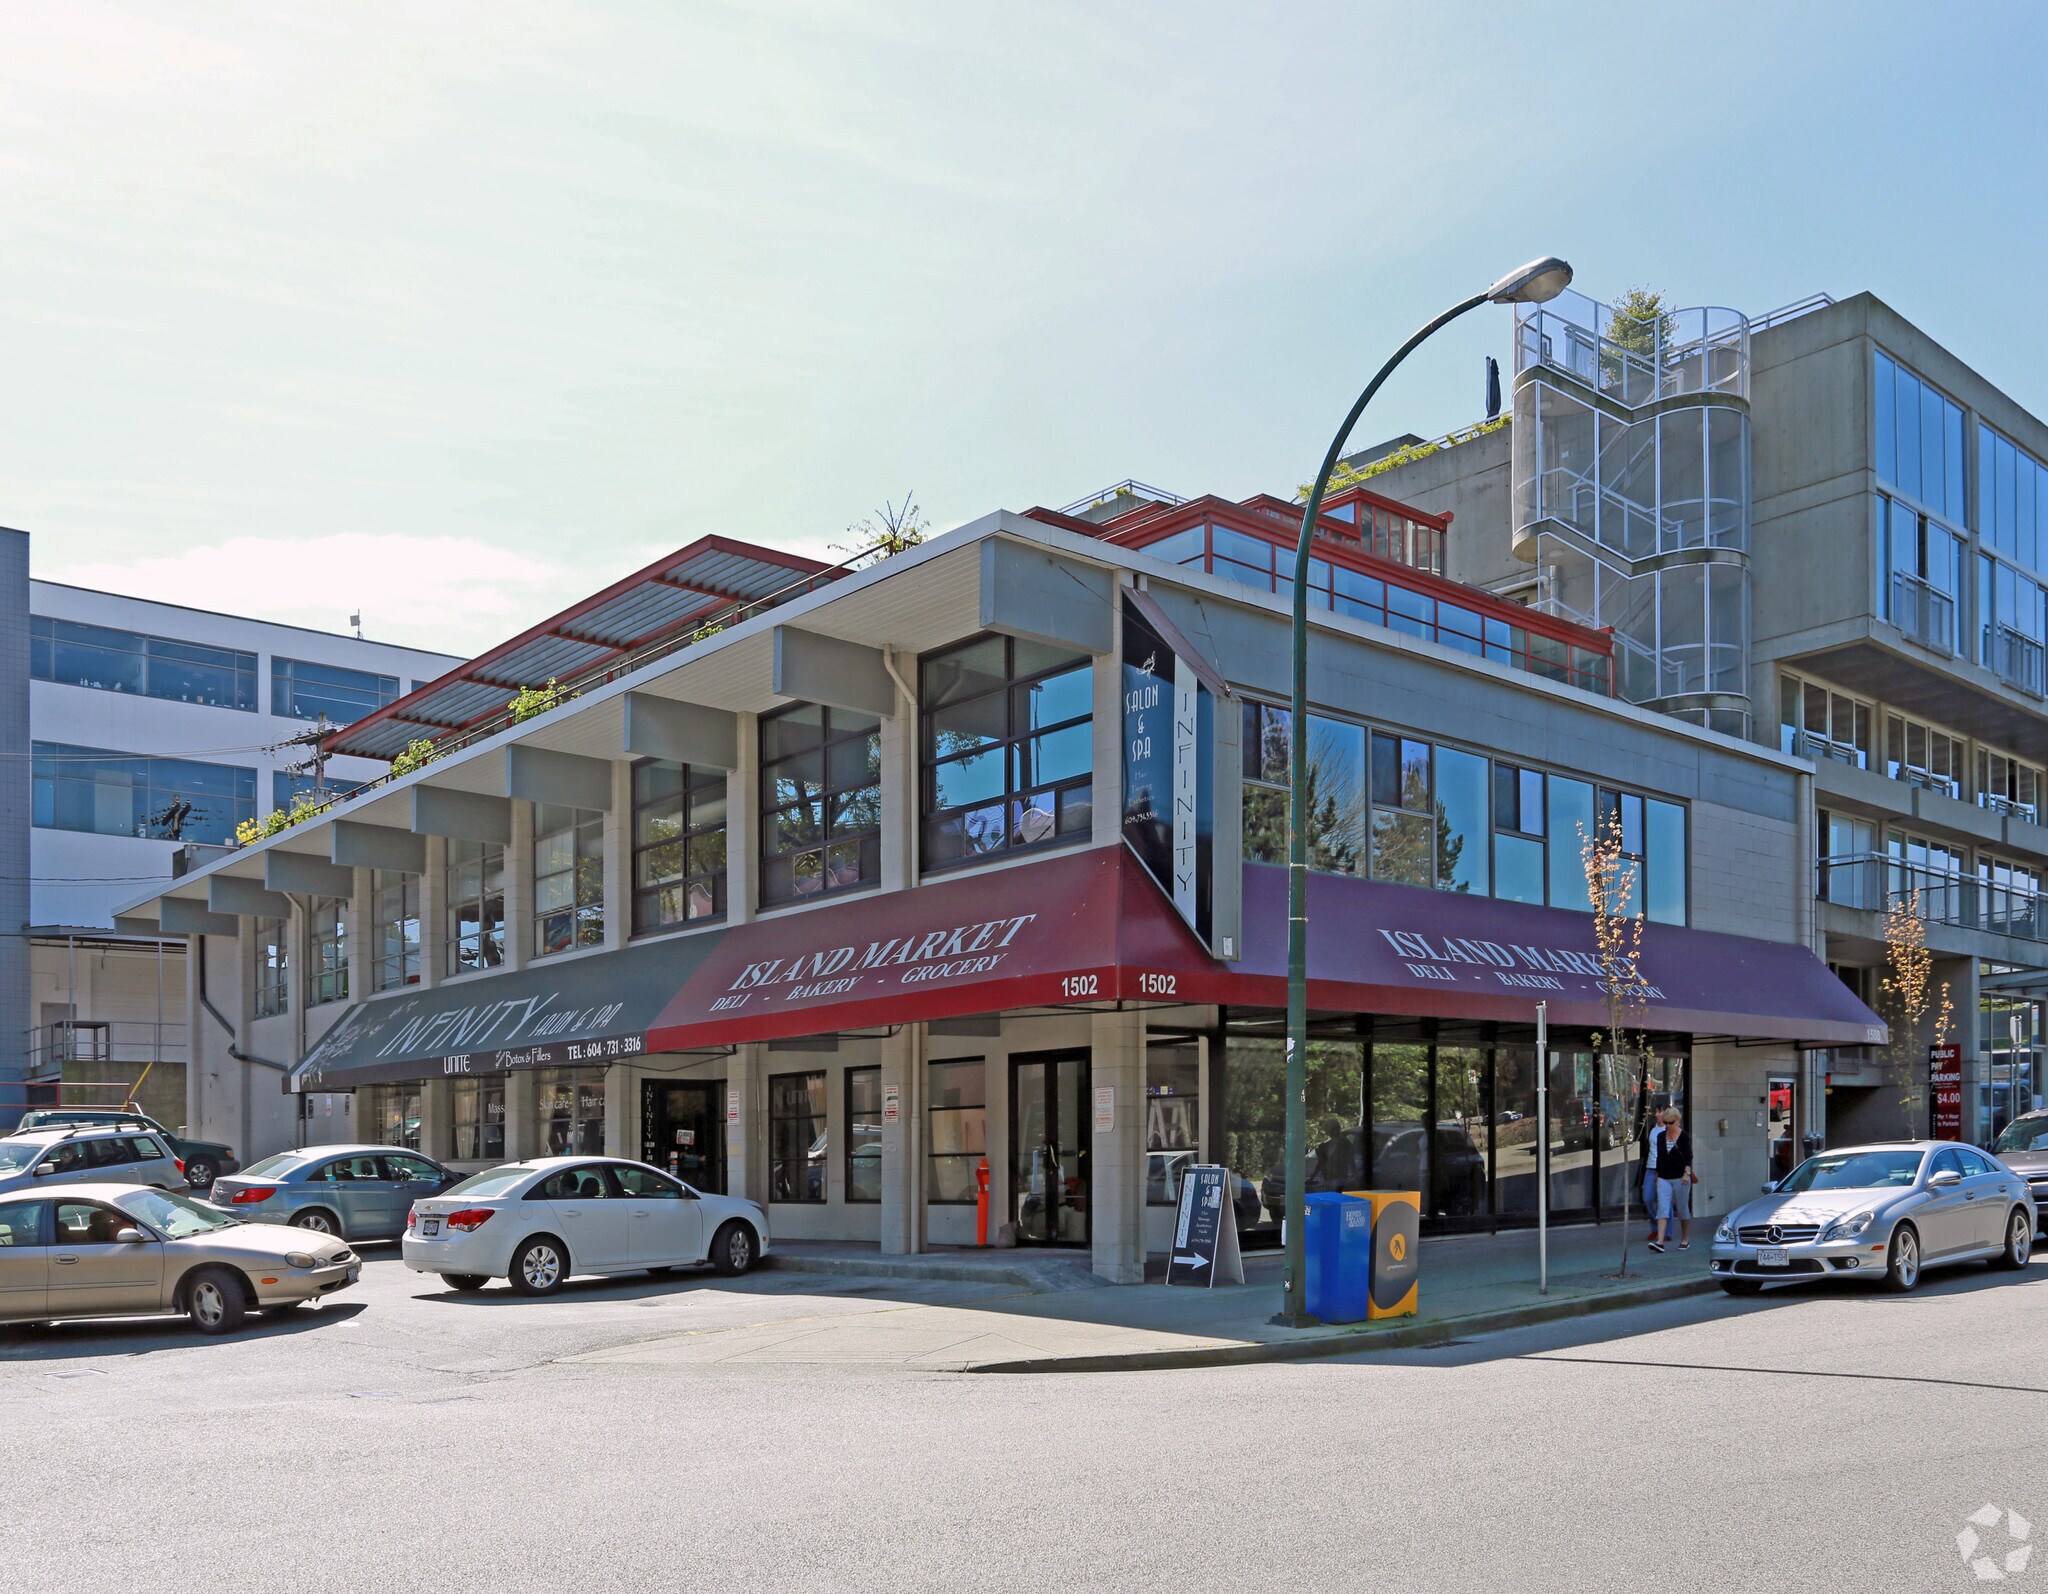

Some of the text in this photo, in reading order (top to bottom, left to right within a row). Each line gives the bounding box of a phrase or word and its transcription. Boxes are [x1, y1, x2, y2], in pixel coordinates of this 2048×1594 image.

[1126, 684, 1159, 715] SALON
[1136, 713, 1145, 735] &
[1132, 736, 1152, 762] SPA
[1175, 692, 1194, 892] INFINITY
[728, 913, 1037, 991] ISLAND MARKET
[1376, 928, 1516, 968] ISLAND
[709, 993, 752, 1012] DELI
[785, 976, 863, 1002] BAKERY
[901, 953, 1009, 985] GROCERY
[1060, 974, 1098, 997] 1502
[1138, 972, 1177, 995] 1502
[1404, 962, 1458, 981] DELI
[1494, 971, 1566, 990] BAKERY
[376, 991, 624, 1058] INFINITY SALON & SPA
[443, 1054, 471, 1074] UNITE
[505, 1050, 526, 1068] Botox
[525, 1053, 531, 1063] &
[531, 1047, 551, 1064] Fillers
[1931, 1049, 1955, 1059] PUBLIC
[1931, 1062, 1943, 1071] PAY
[1931, 1072, 1960, 1082] PARKING
[555, 1099, 569, 1109] care
[582, 1094, 597, 1108] Hair
[1937, 1092, 1960, 1103] $4.00
[1201, 1173, 1219, 1185] SALON
